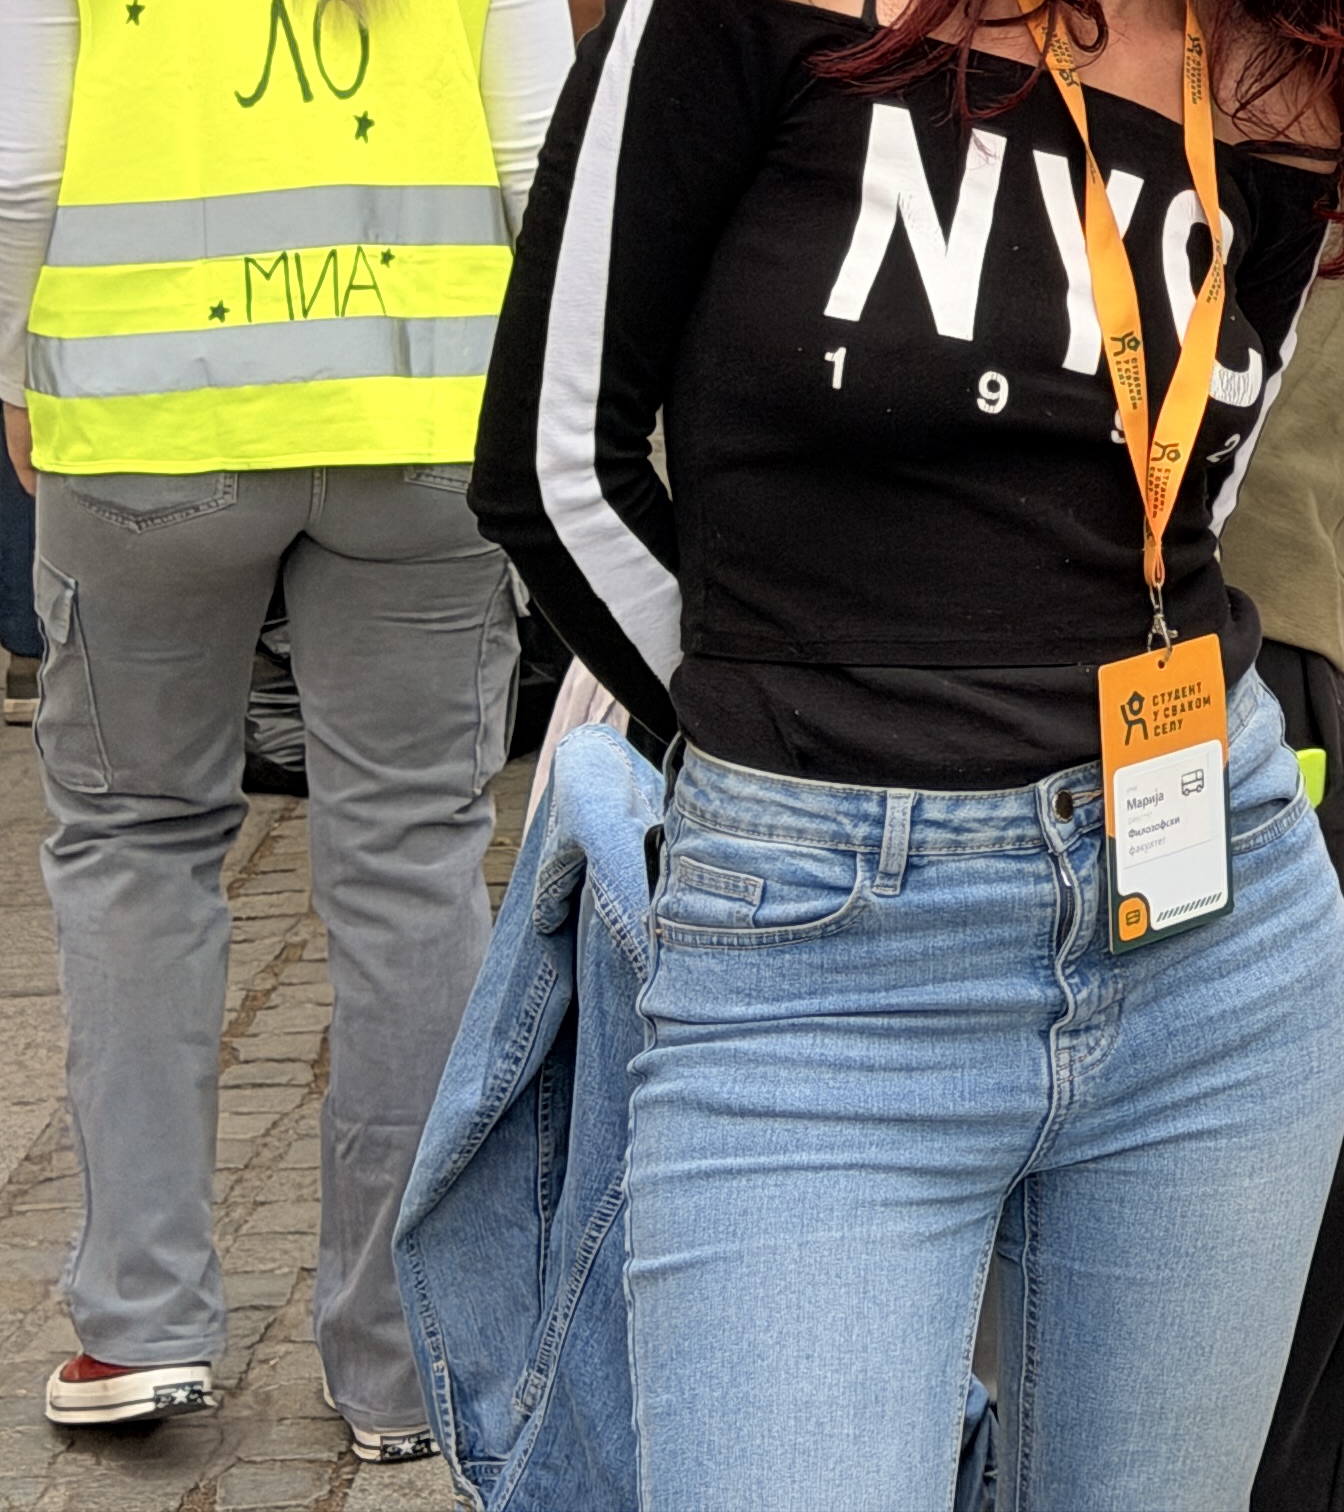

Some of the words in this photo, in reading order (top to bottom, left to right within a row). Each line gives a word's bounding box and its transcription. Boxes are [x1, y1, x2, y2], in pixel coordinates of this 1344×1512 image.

[243, 245, 387, 323] МИА
[1152, 681, 1202, 707] СТУДЕНТ
[1163, 694, 1212, 719] СВАКОМ
[1153, 717, 1184, 737] СЕЛУ
[1126, 788, 1165, 811] Марија
